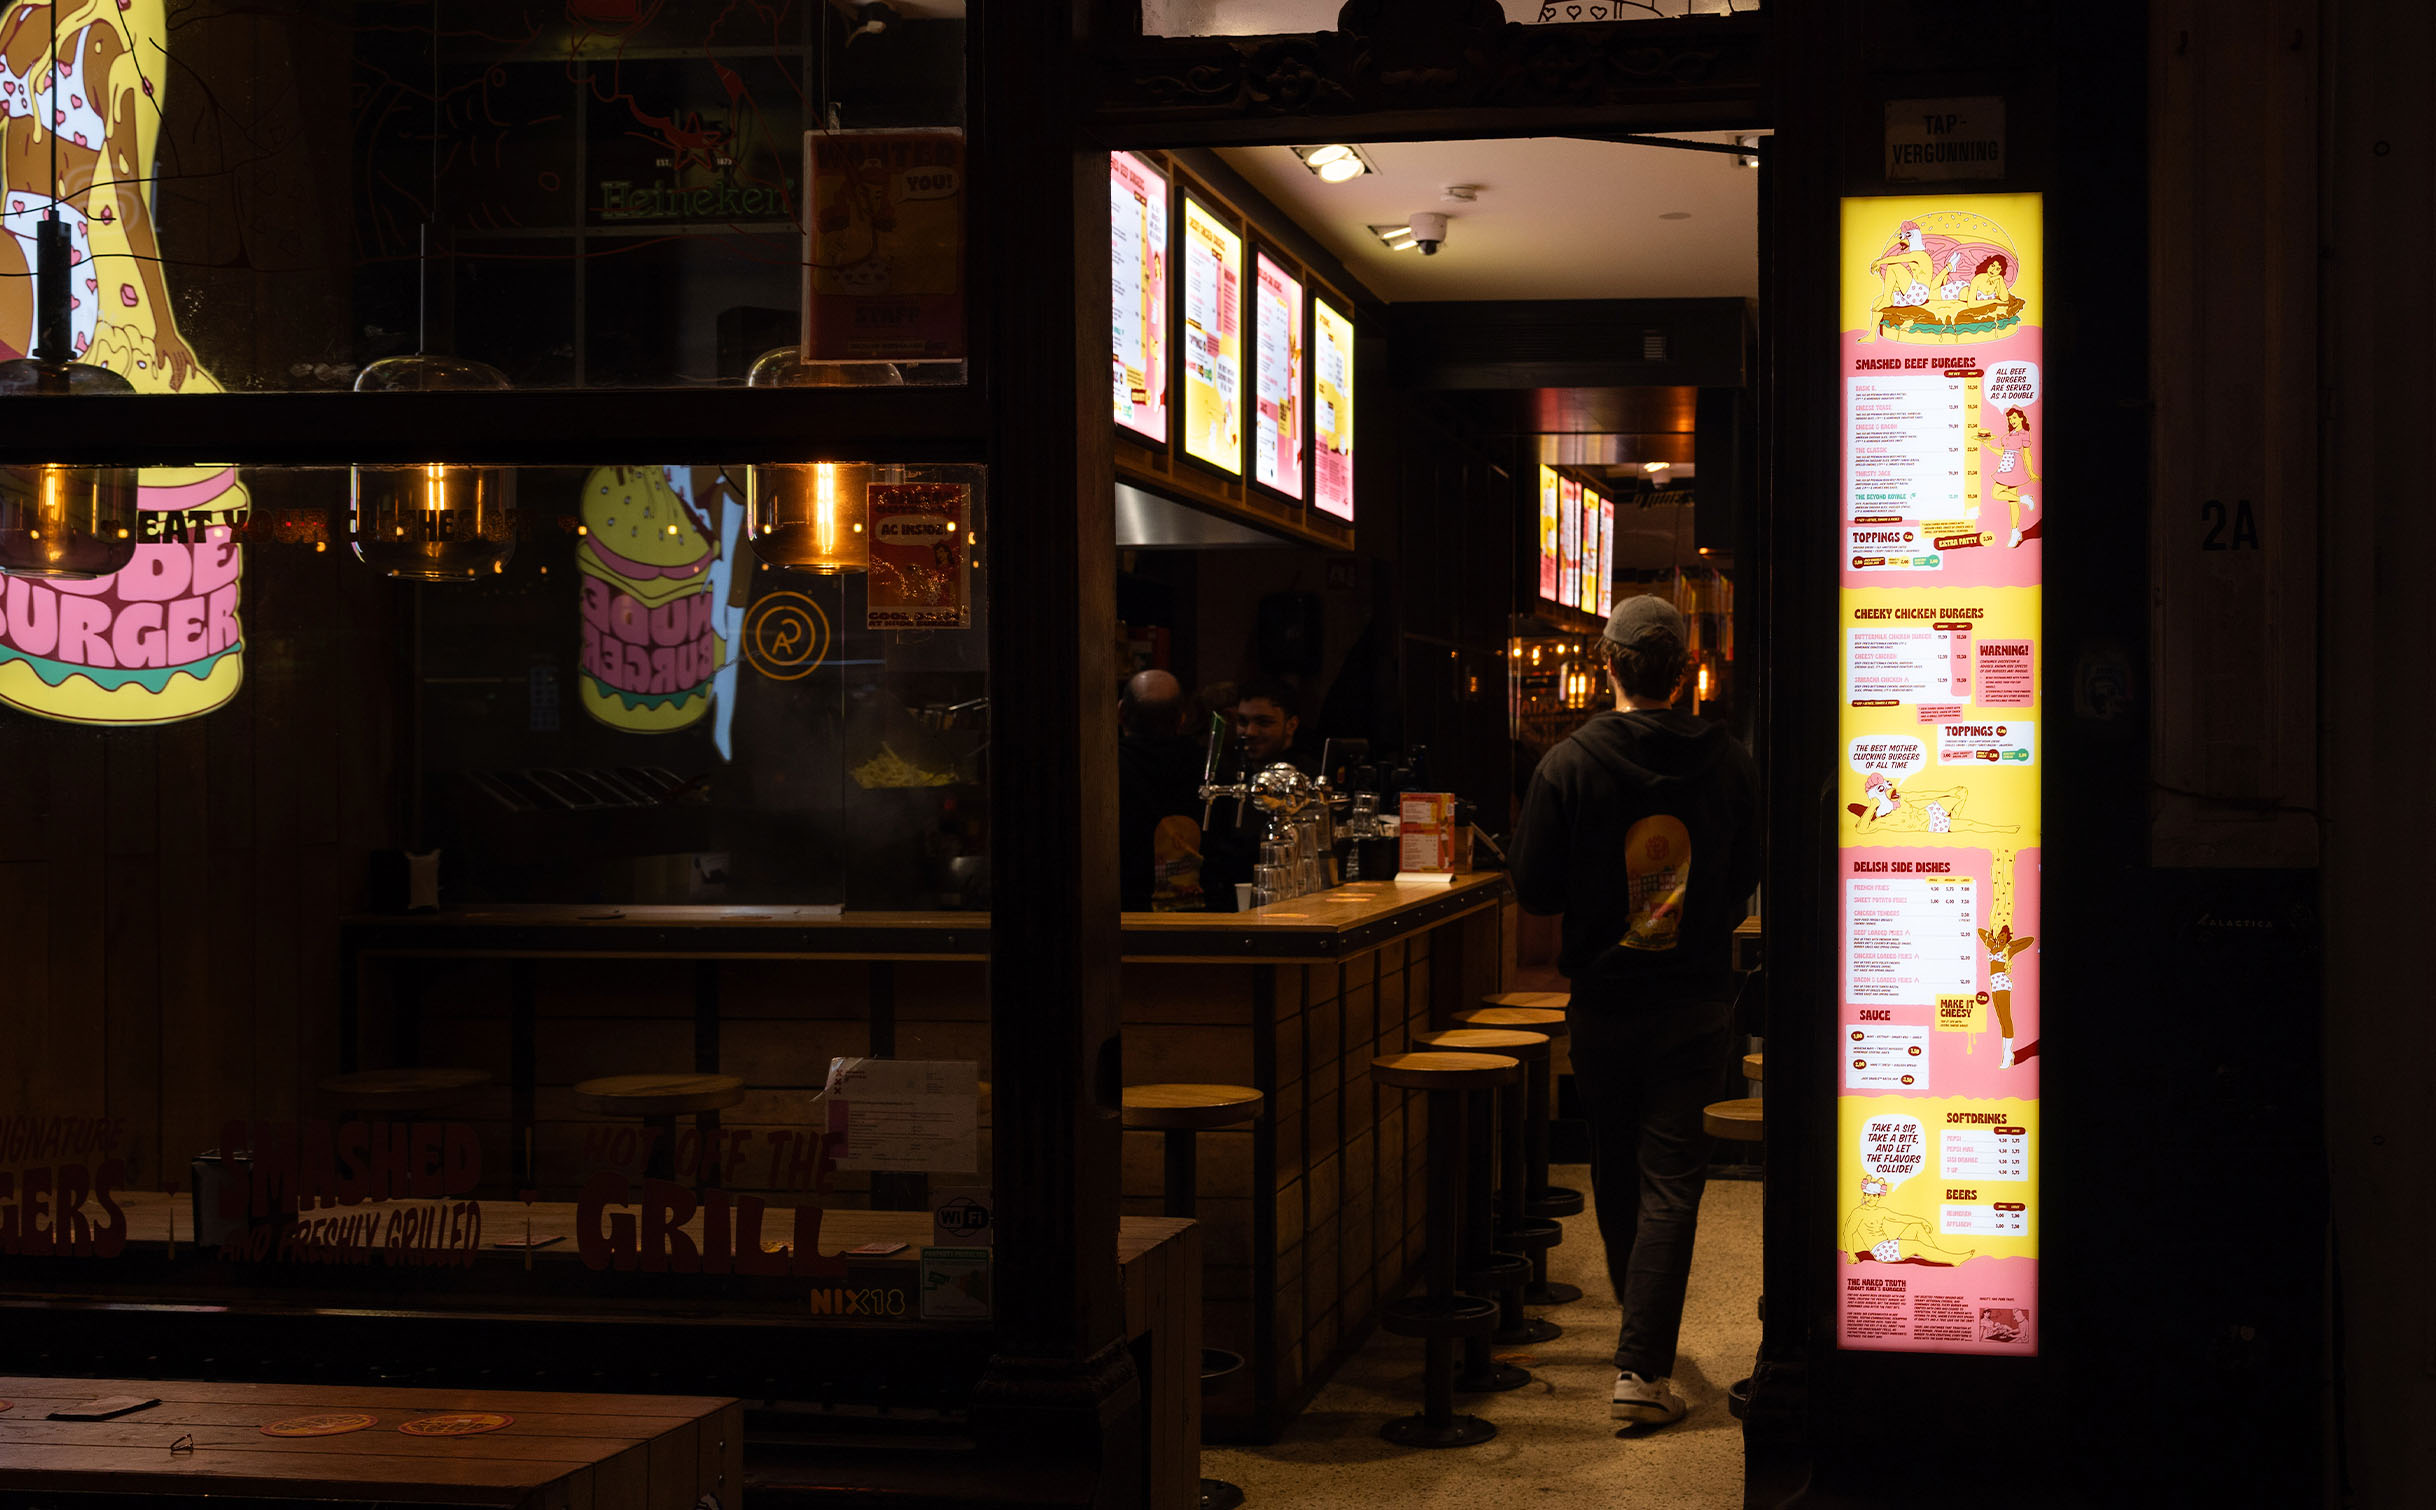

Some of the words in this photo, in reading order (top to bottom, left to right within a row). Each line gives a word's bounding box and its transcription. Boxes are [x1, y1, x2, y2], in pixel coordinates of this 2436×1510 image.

[1923, 115, 1967, 134] TAP-
[1893, 141, 1998, 163] VERGUNNING
[906, 175, 954, 192] YOU!
[601, 180, 796, 217] Heineken
[1856, 358, 1901, 370] SMASHED
[1904, 358, 1929, 369] BEEF
[1931, 357, 1976, 368] BURGERS
[137, 510, 213, 544] EAT
[881, 524, 898, 535] AC
[2202, 500, 2259, 550] 2A
[1853, 532, 1900, 543] TOPPINGS
[1938, 538, 1958, 548] EXTRA
[1958, 536, 1977, 545] PATTY
[1854, 608, 1892, 619] CHEEKY
[1895, 608, 1937, 619] CHICKEN
[1940, 608, 1984, 619] BURGERS
[0, 572, 242, 668] URGER
[1980, 645, 2028, 656] WARNING!
[1945, 726, 1993, 736] TOPPINGS
[1888, 753, 1920, 761] BURGERS
[1854, 862, 1888, 872] DELISH
[1891, 862, 1913, 872] SIDE
[1916, 862, 1951, 873] DISHES
[1941, 1000, 1964, 1008] MAKE
[1966, 1000, 1974, 1009] IT
[1860, 1010, 1891, 1020] SAUCE
[1940, 1009, 1972, 1018] CHEESY
[1947, 1113, 2007, 1124] SOFTDRINKS
[1871, 1124, 1891, 1132] TAKE
[1893, 1124, 1900, 1132] A
[1902, 1124, 1917, 1134] SIP,
[1868, 1134, 1888, 1143] TAKE
[1890, 1134, 1897, 1143] A
[1899, 1134, 1919, 1144] BITE,
[1876, 1144, 1894, 1153] AND
[1896, 1144, 1911, 1153] LET
[583, 1127, 657, 1179] HOT
[675, 1128, 752, 1182] OFF
[768, 1131, 845, 1196] THE
[1866, 1154, 1882, 1163] THE
[1884, 1155, 1921, 1164] FLAVORS
[218, 1119, 481, 1218] SMASHED
[1876, 1165, 1913, 1173] COLLIDE!
[1946, 1189, 1977, 1200] BEERS
[577, 1171, 849, 1276] GRILL
[276, 1211, 382, 1265] FRESHLY
[384, 1201, 482, 1271] GRILLED
[809, 1288, 906, 1316] NIX18
